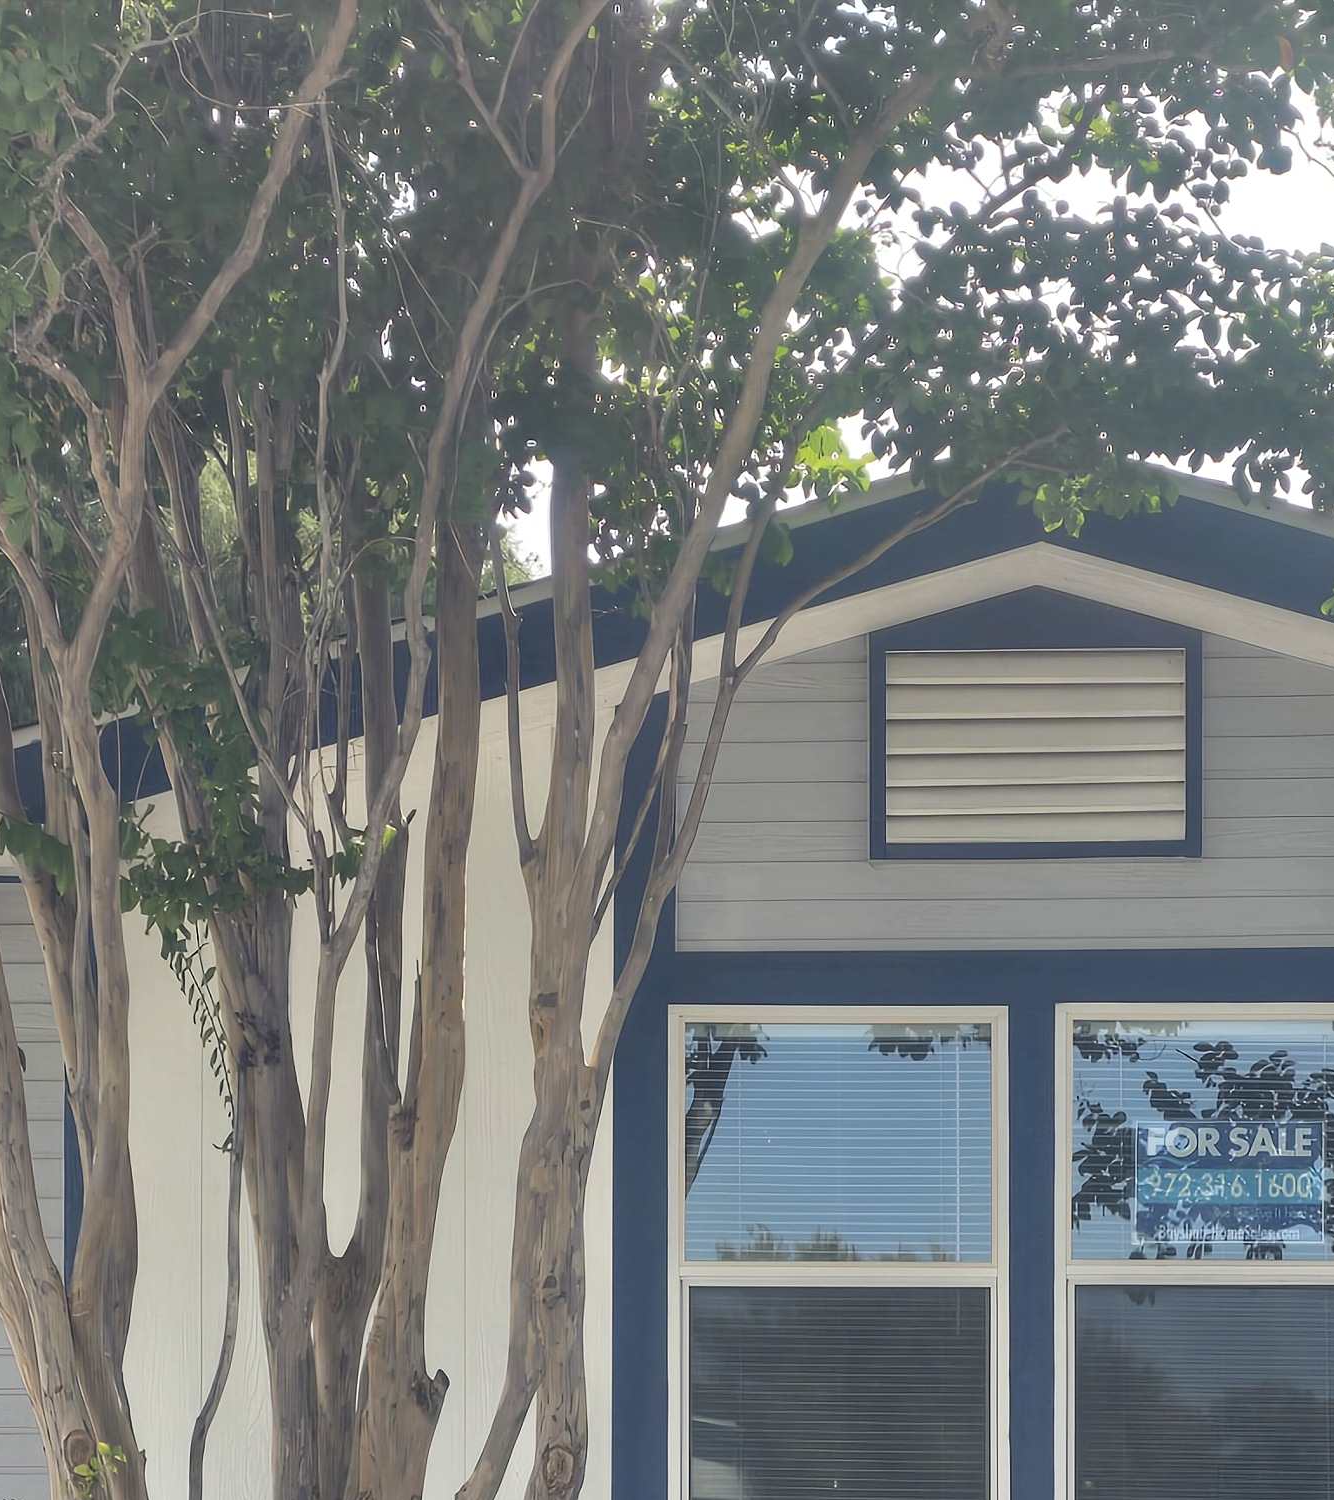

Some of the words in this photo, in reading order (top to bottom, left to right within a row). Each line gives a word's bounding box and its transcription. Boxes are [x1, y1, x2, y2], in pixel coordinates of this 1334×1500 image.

[1146, 1126, 1222, 1158] FOR
[1228, 1126, 1313, 1158] SALE
[1150, 1172, 1312, 1199] 972.316.1600
